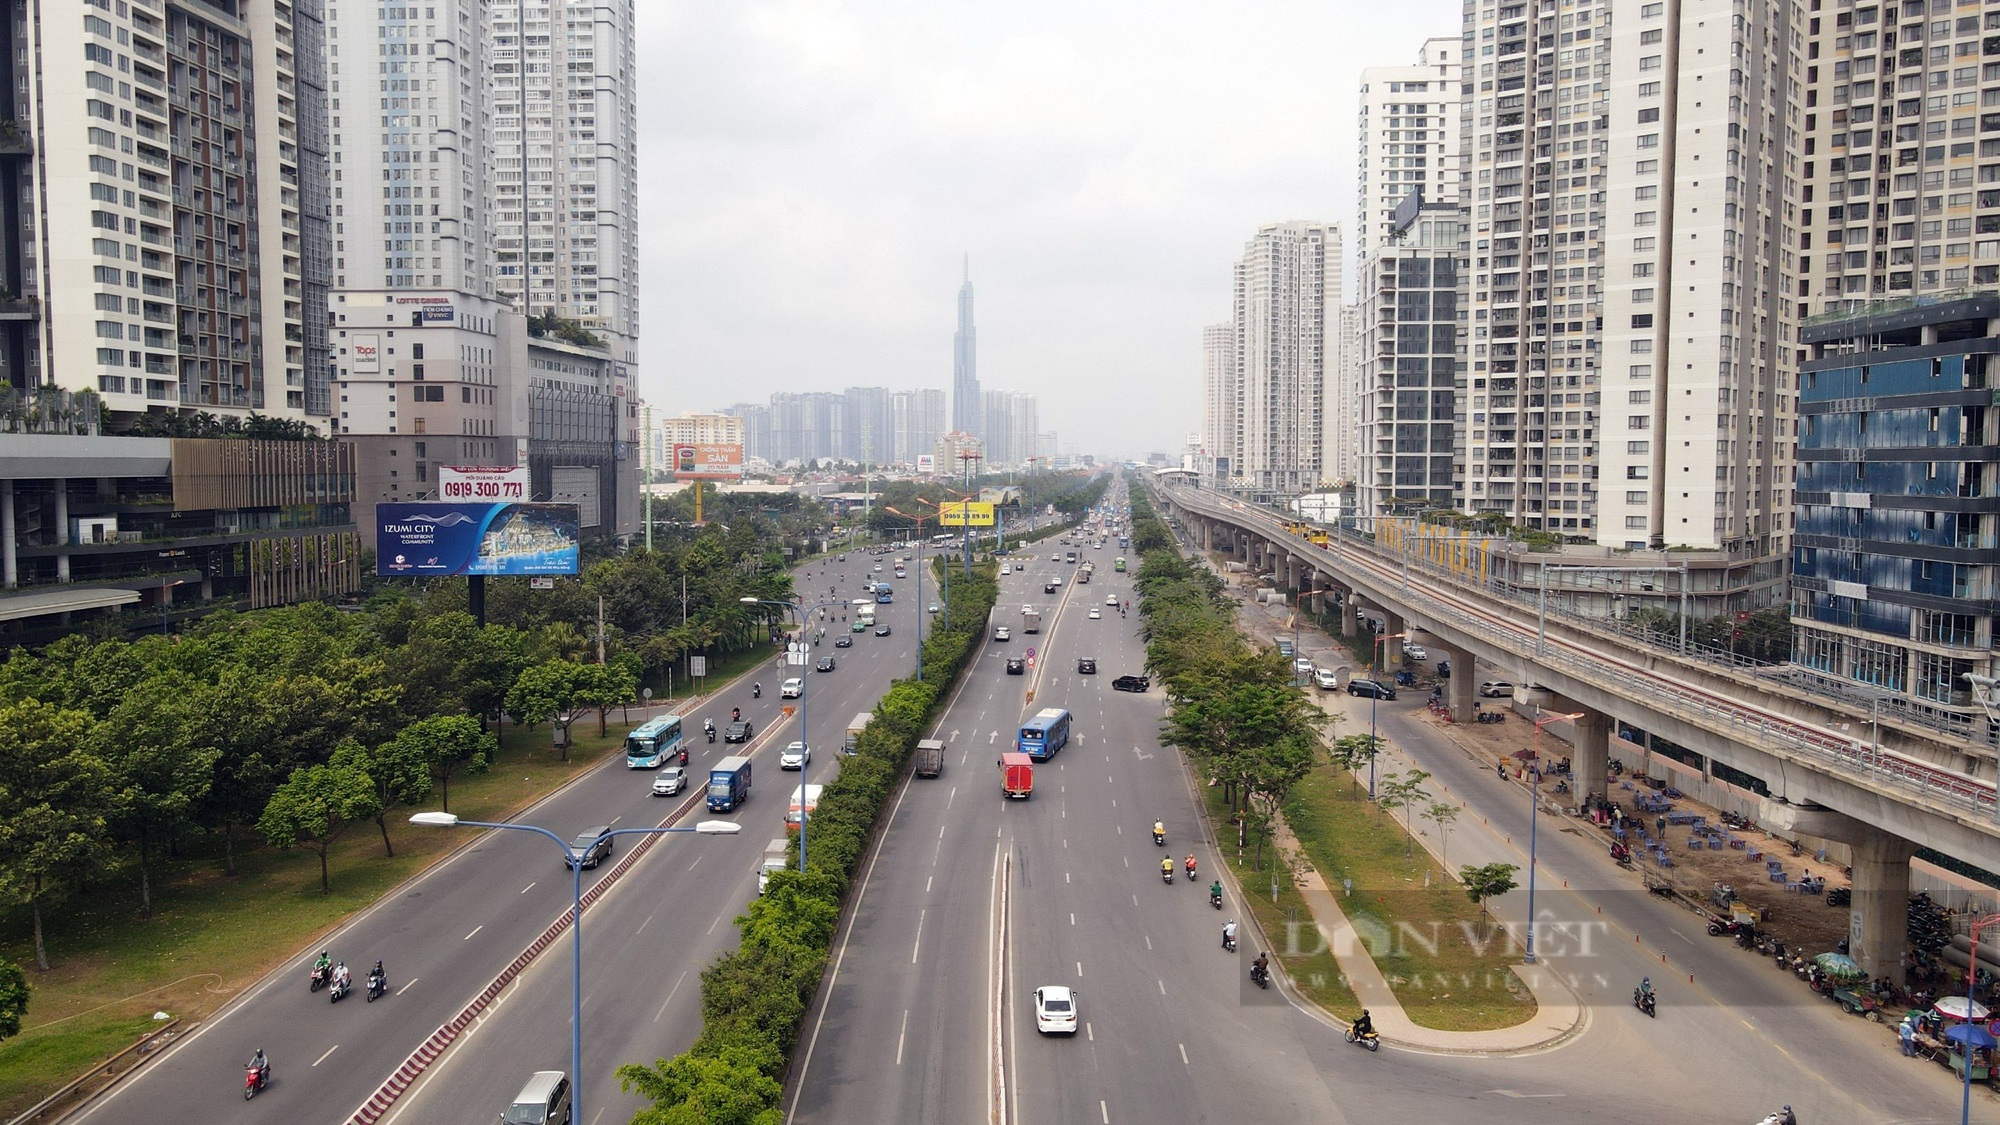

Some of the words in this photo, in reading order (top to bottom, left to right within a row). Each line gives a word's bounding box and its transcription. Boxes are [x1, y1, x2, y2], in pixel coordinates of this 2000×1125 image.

[355, 345, 376, 357] Tops
[707, 453, 728, 463] SÀN
[445, 482, 472, 497] 0919
[475, 482, 500, 497] 300
[503, 482, 522, 497] 771
[385, 524, 412, 533] IZUMI
[414, 524, 436, 533] CITY
